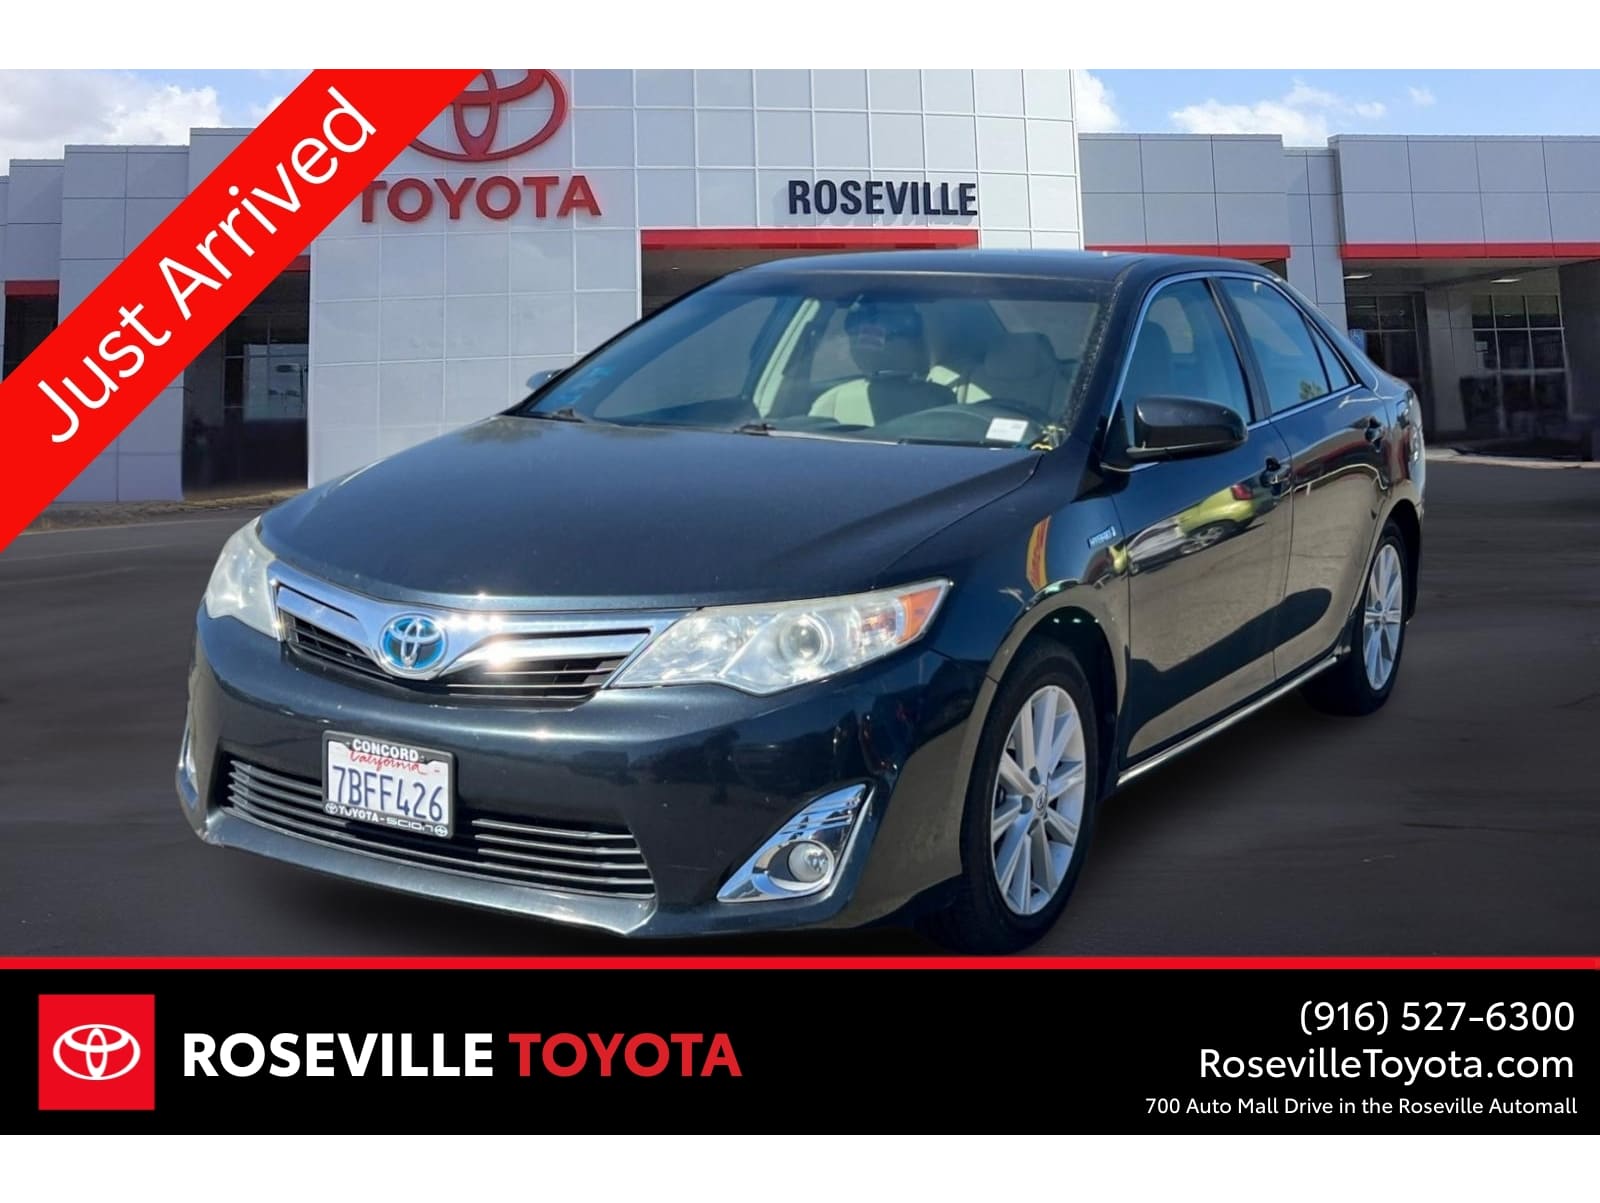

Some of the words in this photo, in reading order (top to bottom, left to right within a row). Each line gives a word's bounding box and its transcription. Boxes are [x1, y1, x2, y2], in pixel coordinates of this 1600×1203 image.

[361, 175, 602, 223] TOYOTA
[788, 179, 978, 216] ROSEVILLE
[352, 738, 419, 762] CONCORD
[332, 765, 443, 822] 7BFF426
